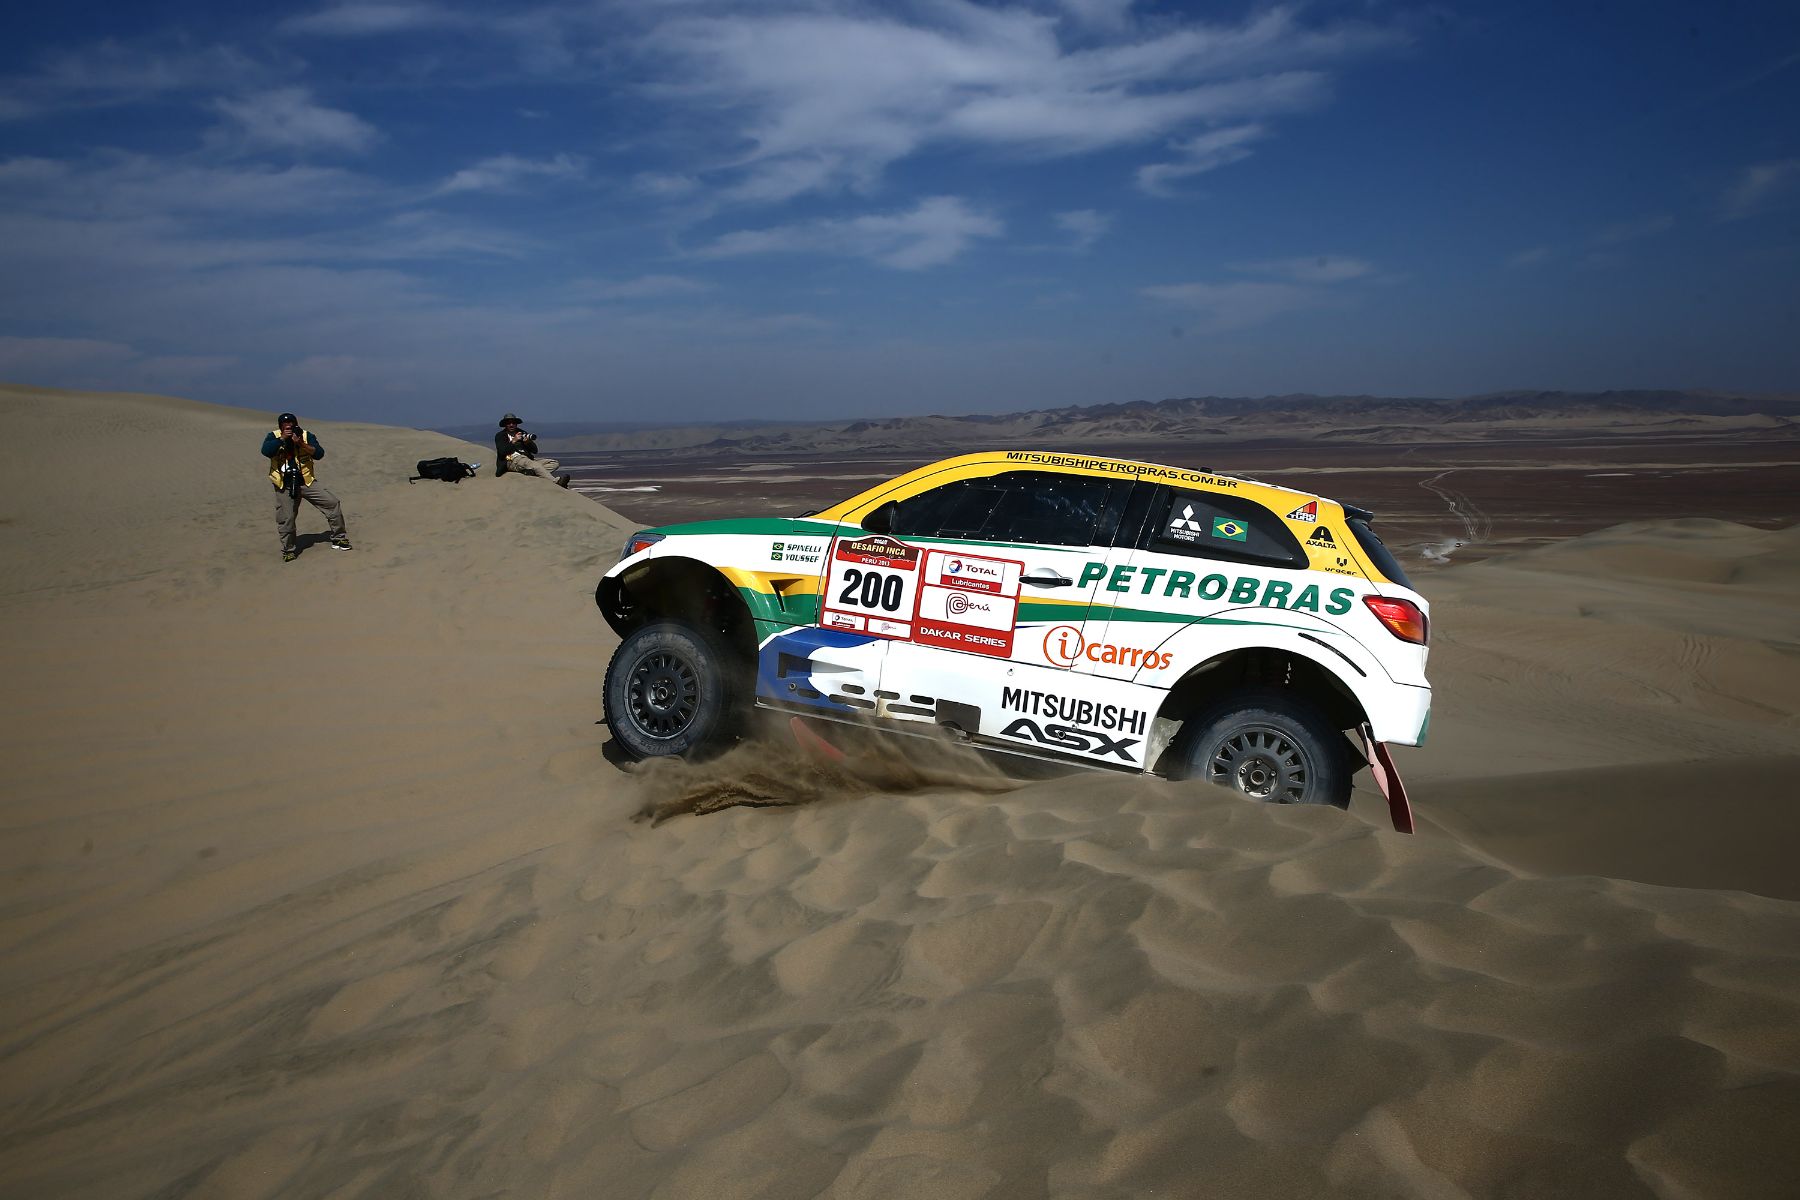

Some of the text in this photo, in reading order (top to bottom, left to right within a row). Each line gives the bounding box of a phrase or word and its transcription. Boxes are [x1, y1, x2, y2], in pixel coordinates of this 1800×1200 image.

[1006, 451, 1238, 489] MITSUBISHIPETROBRAS.COM.BR
[1170, 527, 1200, 537] MITSUBISHI
[1173, 533, 1195, 542] MOTORS
[786, 543, 822, 553] SPINELLI
[1305, 540, 1337, 549] AXALTA
[886, 546, 906, 556] INCA
[785, 553, 820, 563] YOUSSEF
[838, 568, 904, 612] 200
[951, 578, 990, 590] Lubricantes
[1077, 561, 1355, 616] PETROBRAS
[920, 626, 1006, 648] DAKAR SERIES
[1001, 686, 1147, 736] MITSUBISHI
[999, 717, 1142, 763] ASX
